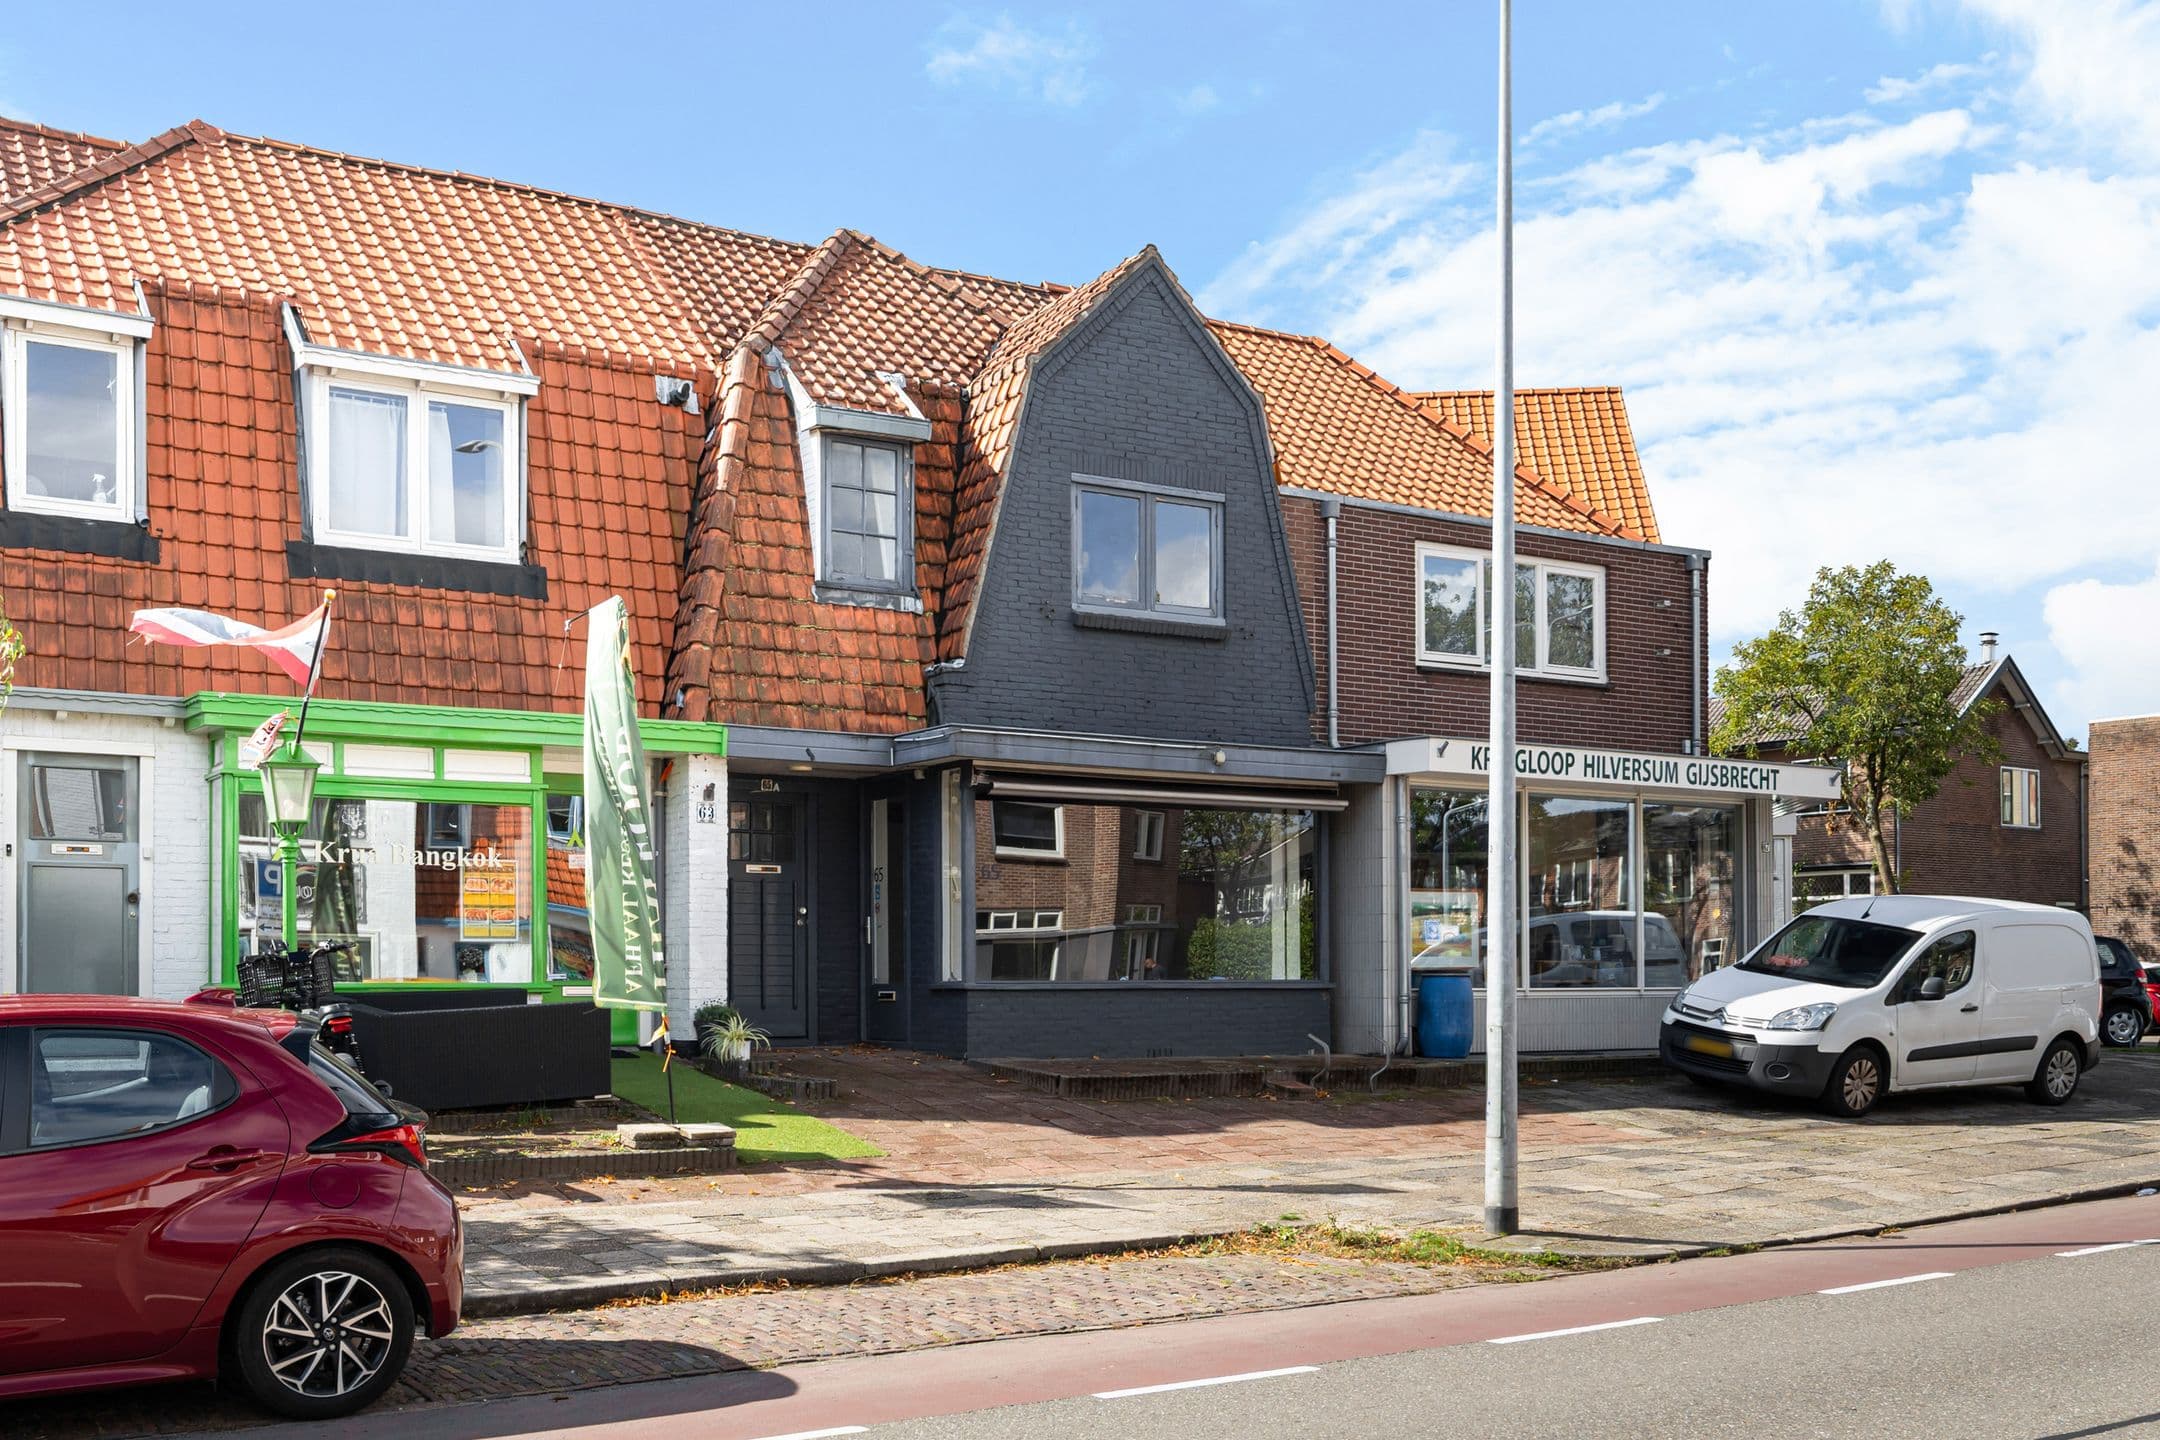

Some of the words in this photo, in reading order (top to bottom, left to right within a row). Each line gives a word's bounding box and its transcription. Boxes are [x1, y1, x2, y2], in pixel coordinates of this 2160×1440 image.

[1583, 753, 1679, 784] HILVERSUM
[1686, 762, 1780, 790] GIJSBRECHT
[390, 843, 504, 871] Bangkok
[874, 866, 884, 882] 65
